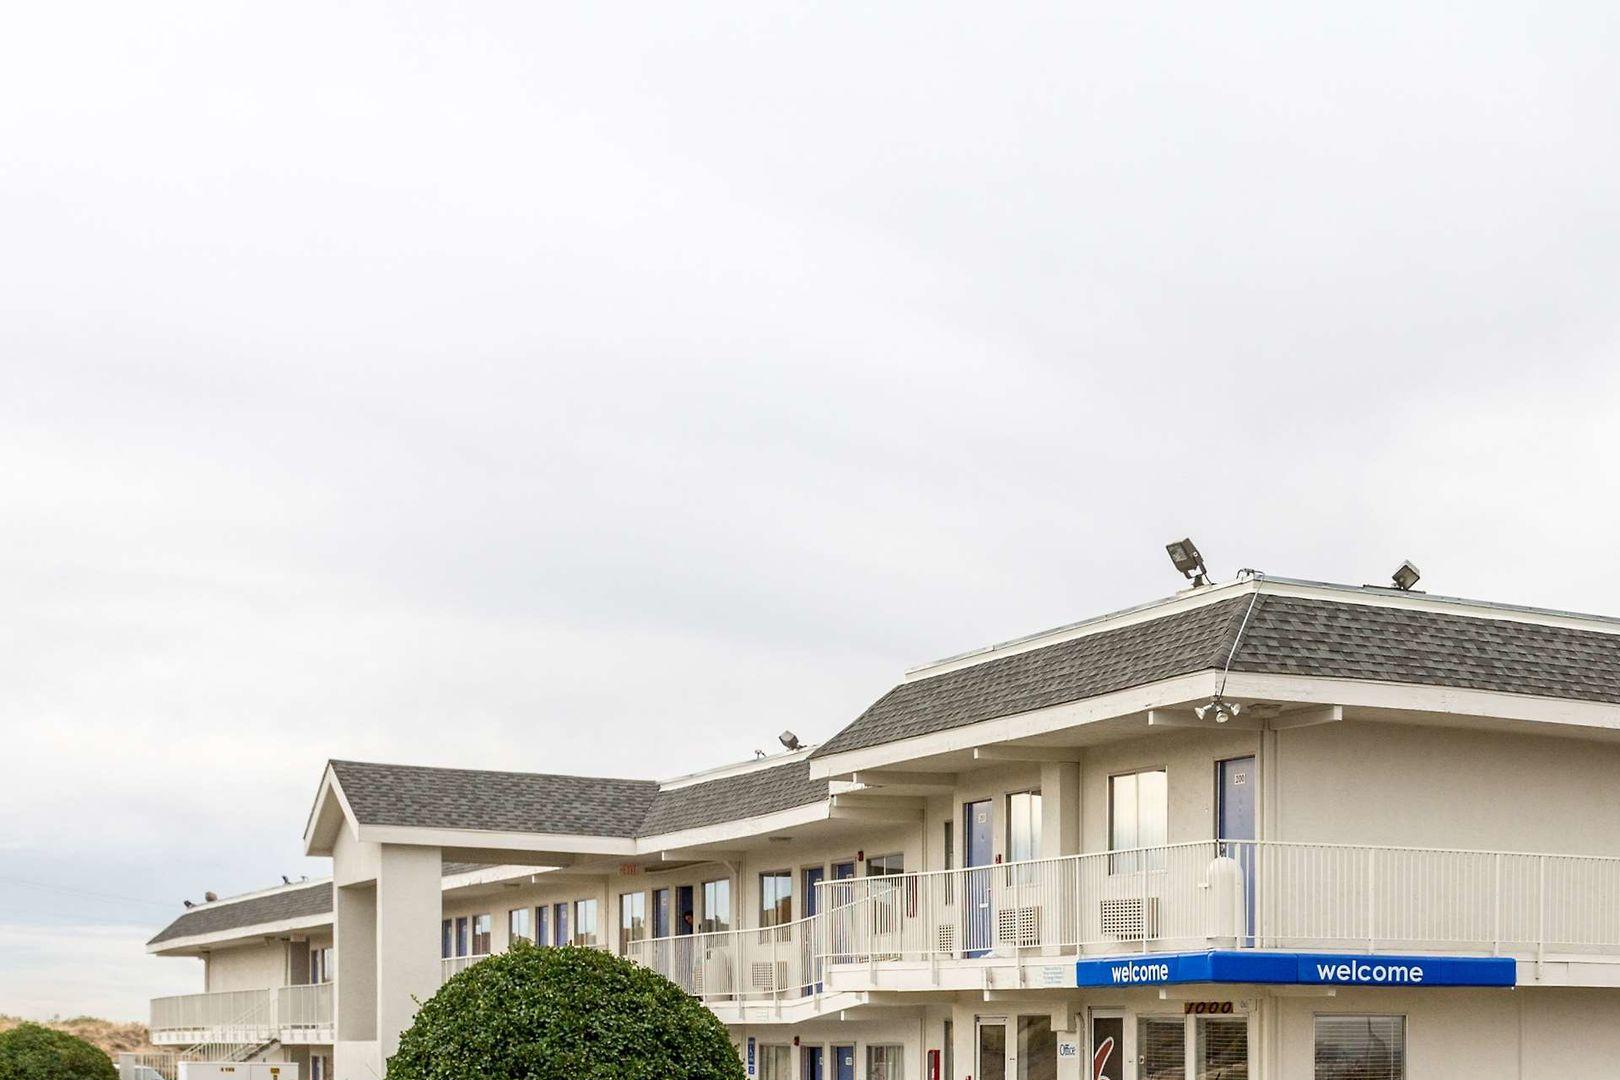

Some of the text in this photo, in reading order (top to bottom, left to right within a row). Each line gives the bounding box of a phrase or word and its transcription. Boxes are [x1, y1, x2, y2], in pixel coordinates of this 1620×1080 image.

[1111, 961, 1169, 983] welcome
[1316, 959, 1424, 983] welcome
[1185, 1001, 1232, 1014] 1000
